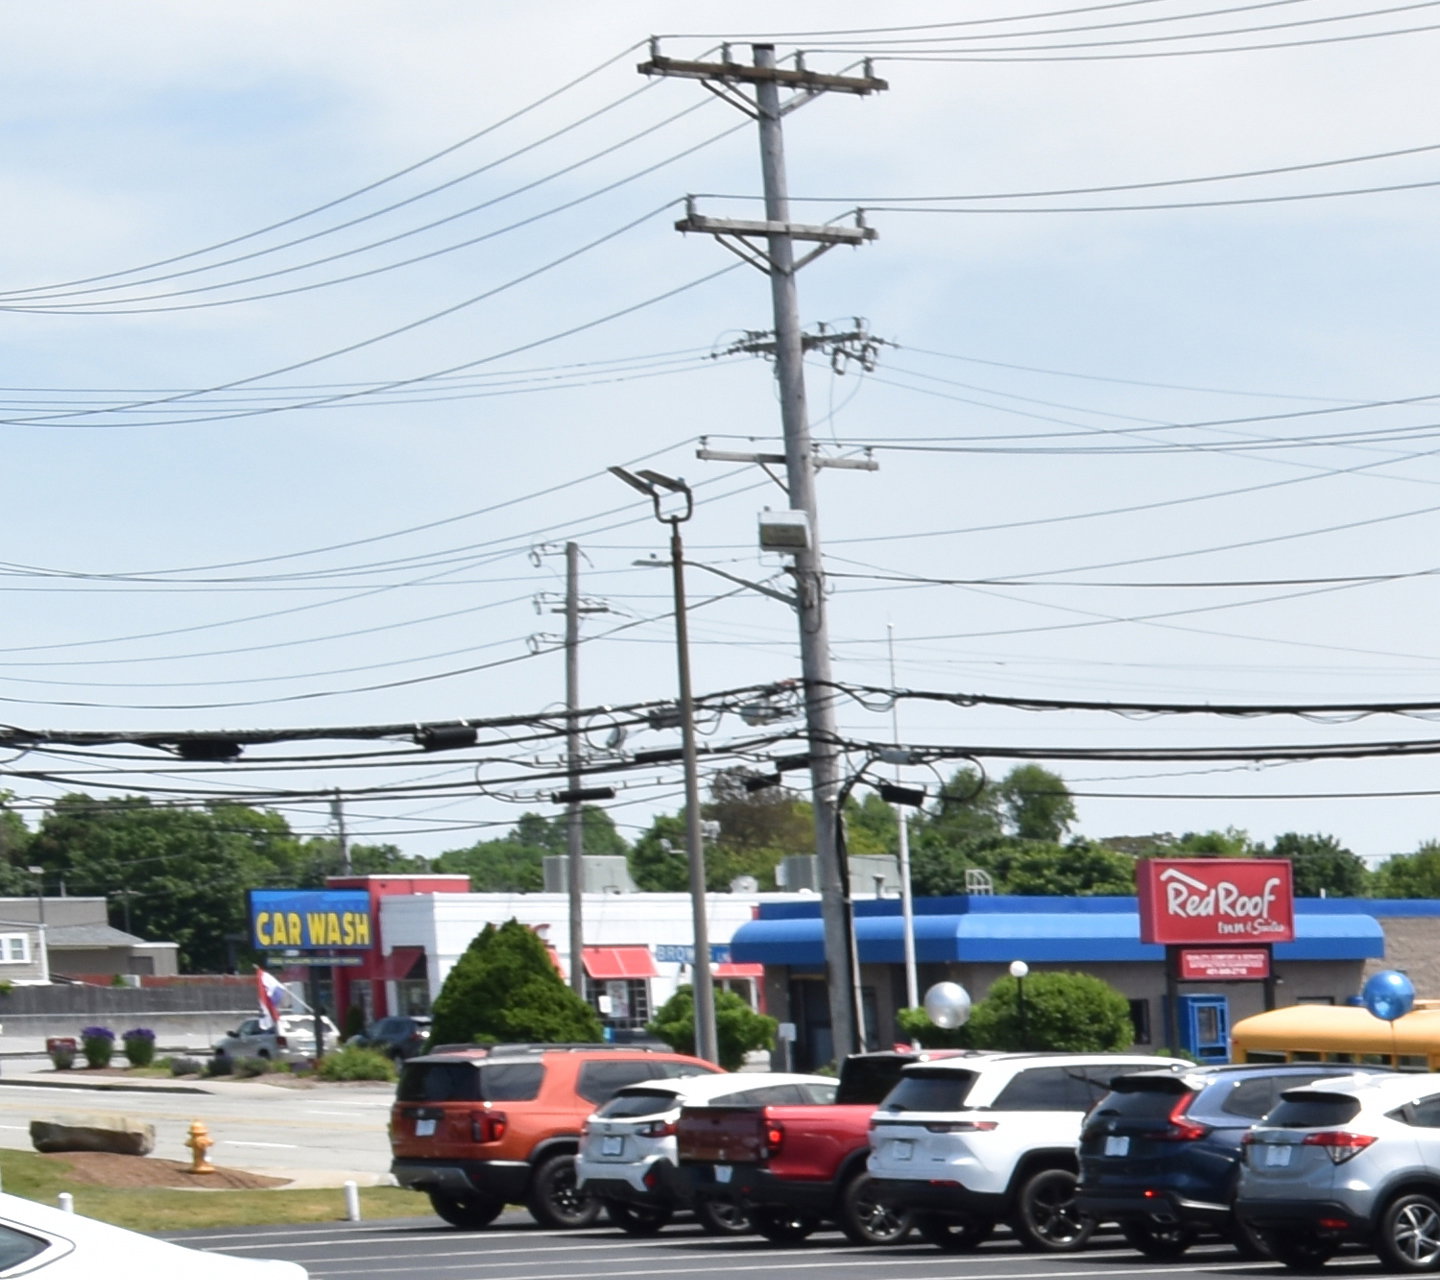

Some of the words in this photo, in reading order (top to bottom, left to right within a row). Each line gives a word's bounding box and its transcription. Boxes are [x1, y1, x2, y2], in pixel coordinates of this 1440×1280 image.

[1217, 877, 1281, 919] Roof
[256, 911, 302, 946] CAR
[306, 911, 371, 946] WASH
